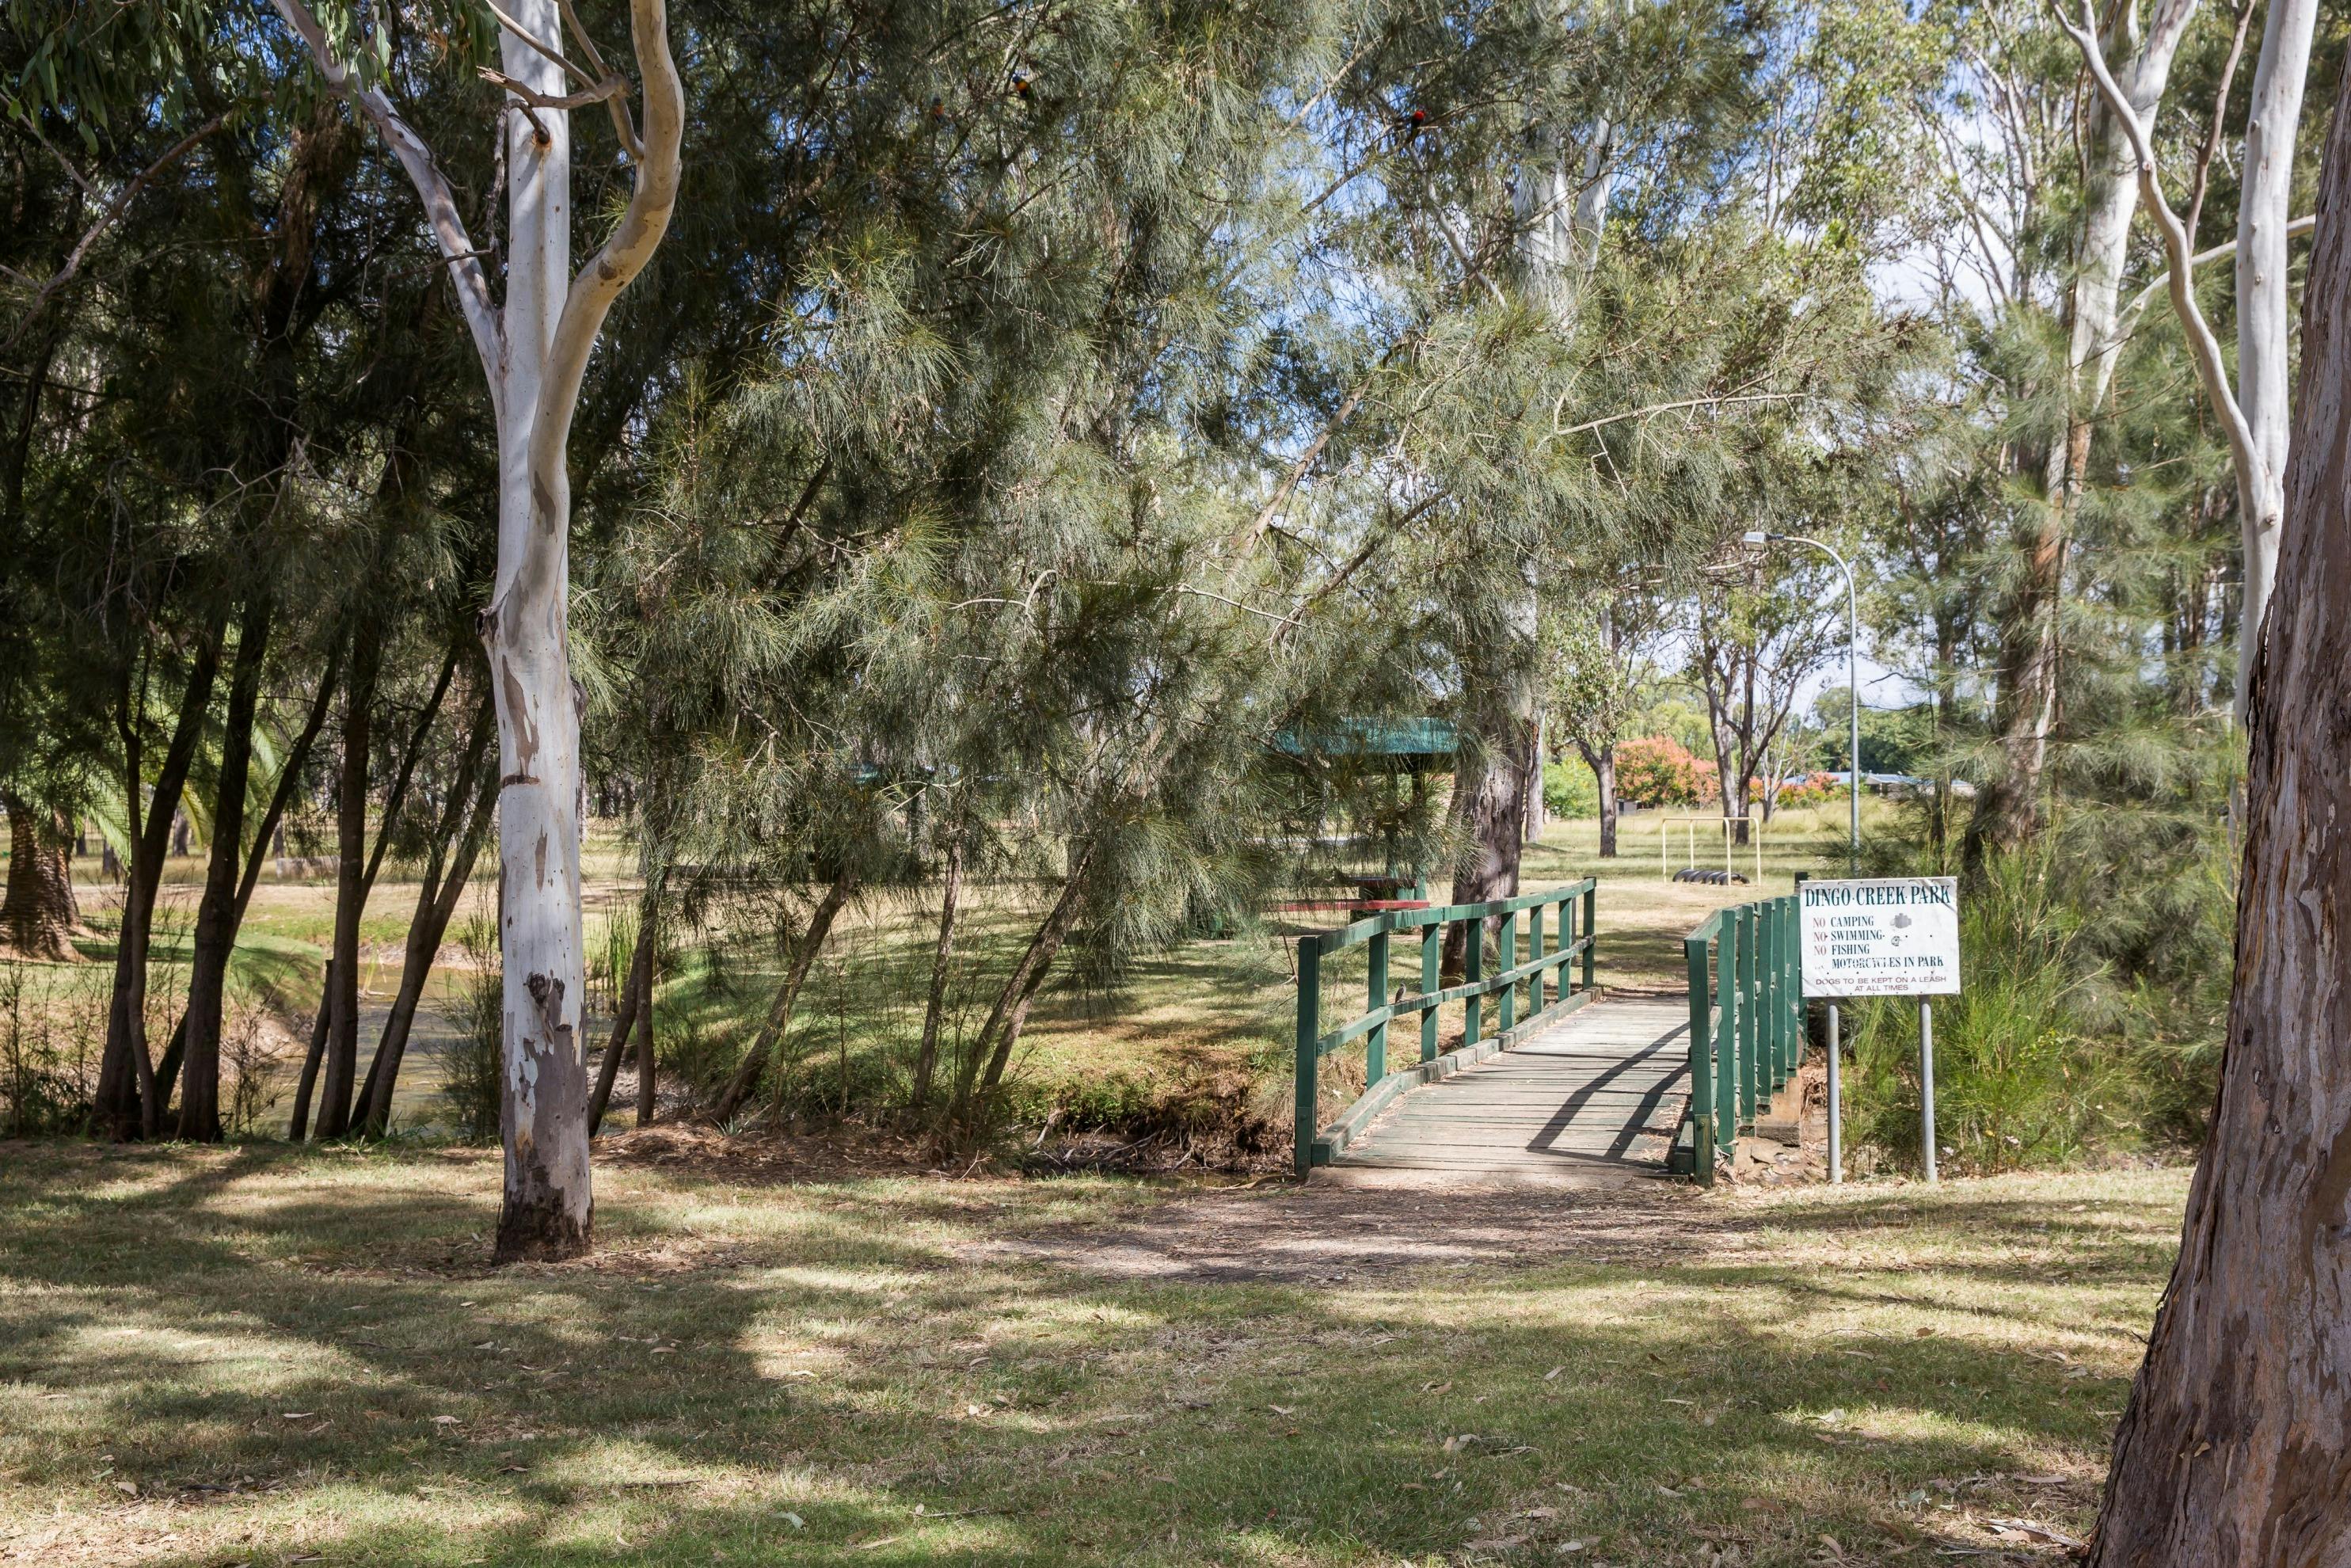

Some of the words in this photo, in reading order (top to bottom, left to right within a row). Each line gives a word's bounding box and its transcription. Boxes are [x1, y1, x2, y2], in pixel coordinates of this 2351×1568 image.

[1805, 888, 1850, 907] DINGO
[1856, 887, 1905, 905] CREEK
[1911, 885, 1951, 904] PARK
[1813, 918, 1825, 928] NO
[1831, 916, 1874, 927] CAMPING
[1813, 932, 1826, 942] NO
[1831, 930, 1882, 941] SWIMMING
[1813, 946, 1826, 956] NO
[1832, 944, 1870, 955] FISHING
[1904, 957, 1914, 967] IN
[1918, 956, 1944, 967] PARK
